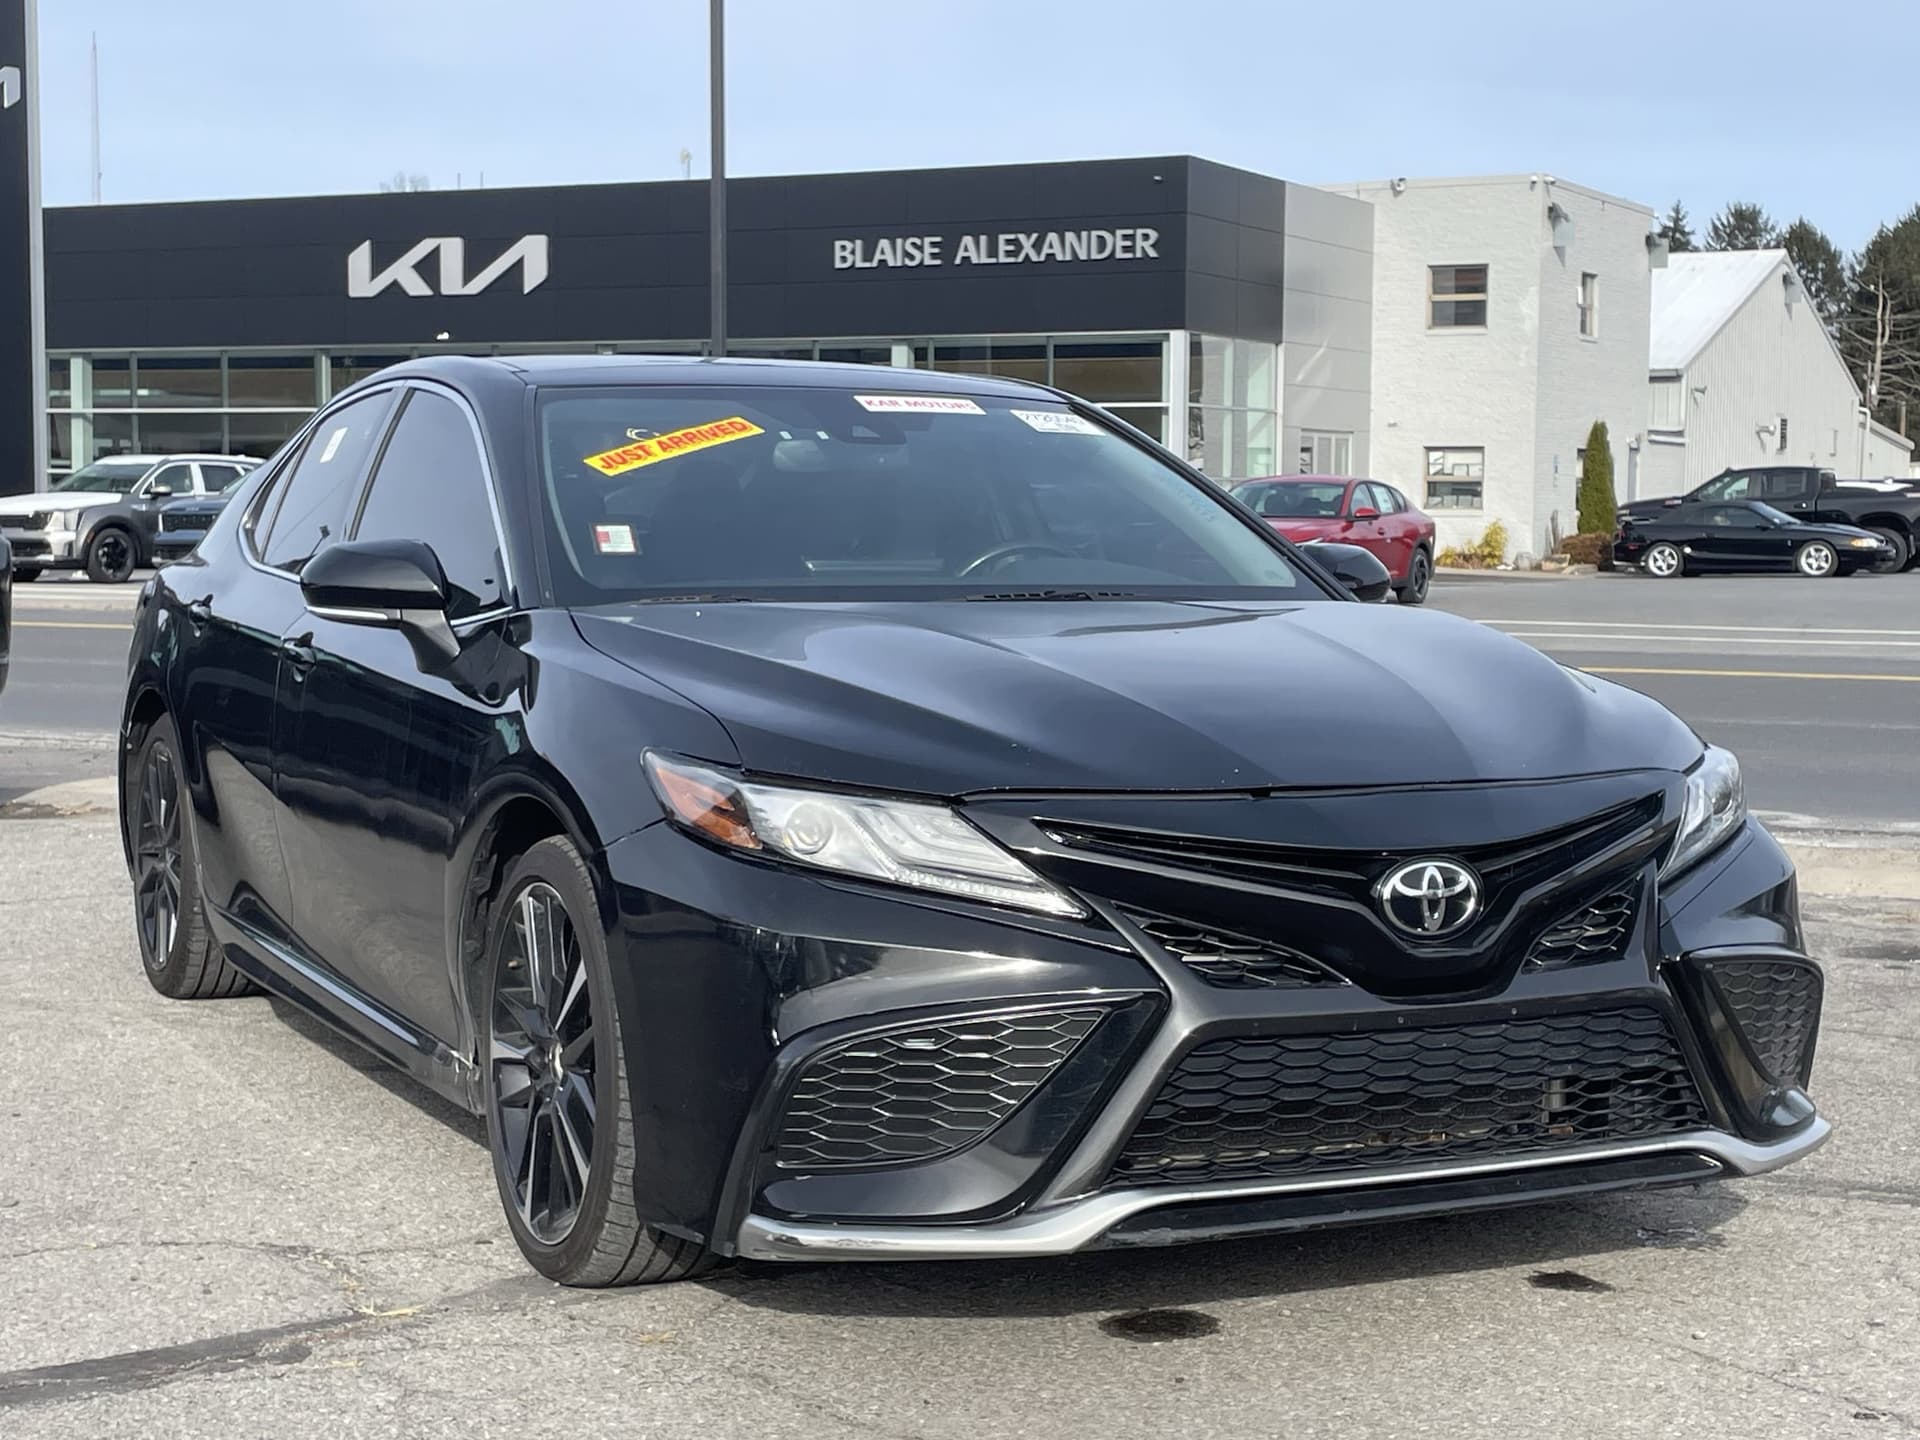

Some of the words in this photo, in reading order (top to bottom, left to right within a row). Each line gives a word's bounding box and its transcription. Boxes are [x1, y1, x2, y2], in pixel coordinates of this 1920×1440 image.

[348, 235, 549, 298] KIA
[834, 236, 943, 269] BLAISE
[954, 228, 1160, 265] ALEXANDER
[903, 400, 977, 410] MOTORS
[600, 444, 655, 470] JUST
[656, 420, 750, 453] ARRIVED
